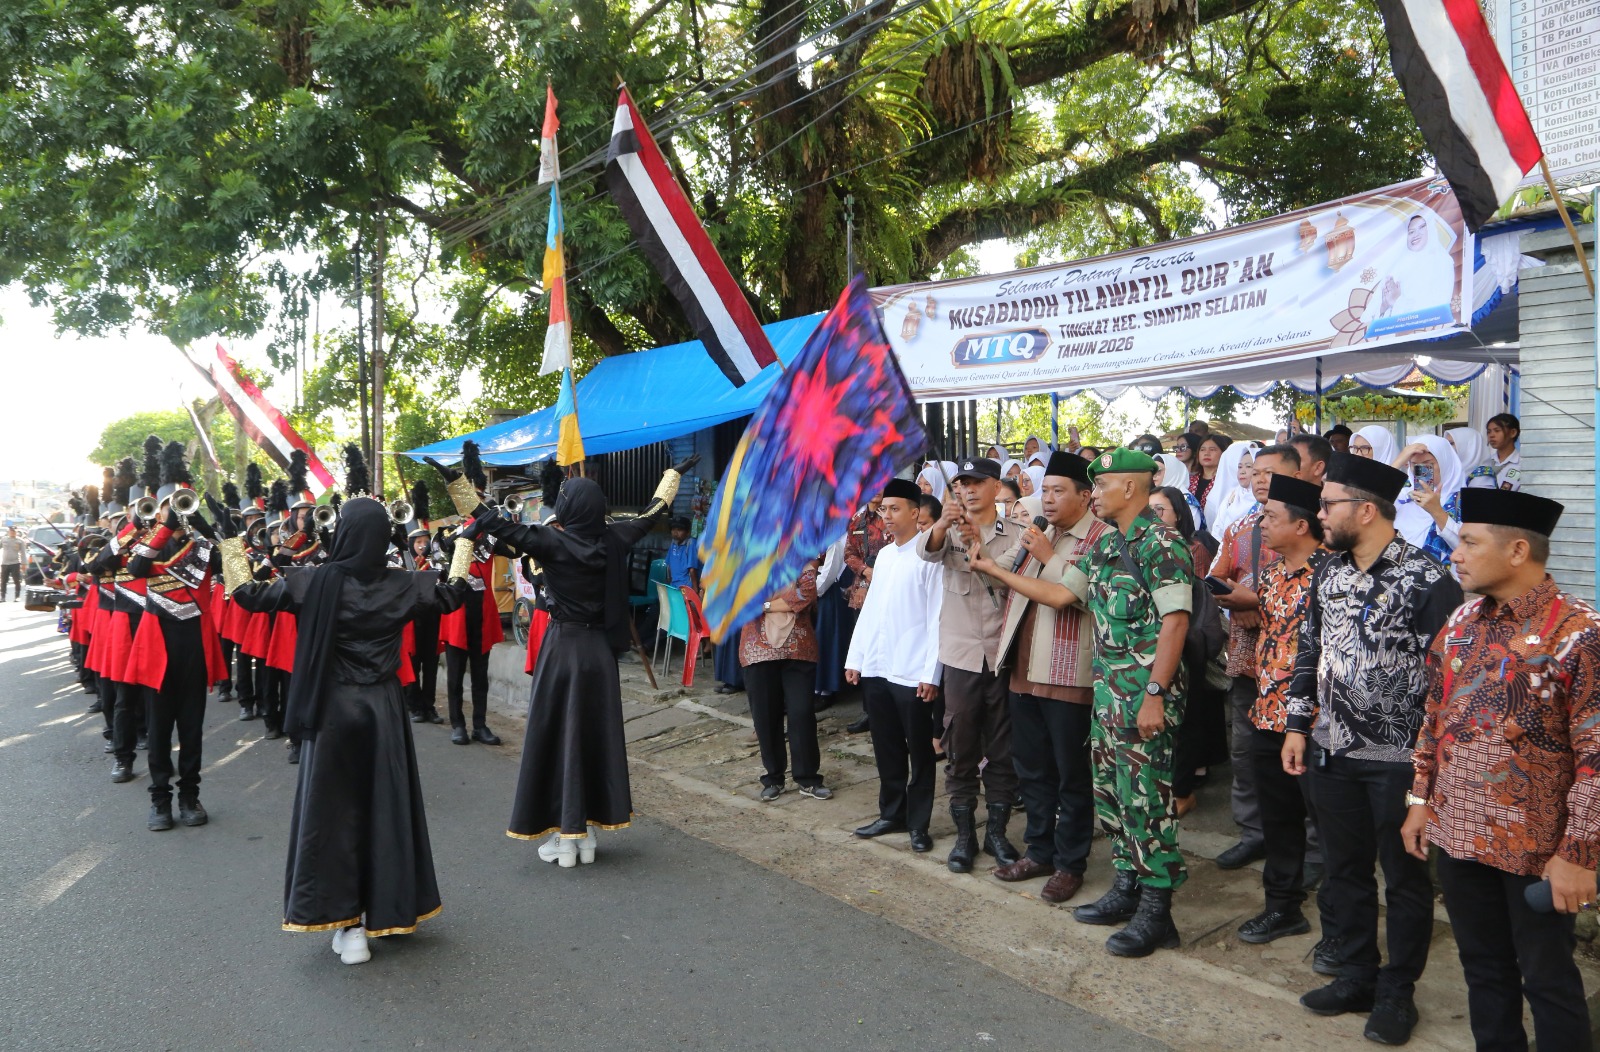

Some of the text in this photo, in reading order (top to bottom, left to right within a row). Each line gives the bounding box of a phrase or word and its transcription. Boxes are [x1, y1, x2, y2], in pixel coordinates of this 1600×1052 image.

[1521, 16, 1527, 24] 4
[1521, 29, 1528, 38] 5
[1542, 20, 1555, 31] KB
[1521, 26, 1582, 52] 6 TB Paru
[1522, 35, 1592, 65] 7 Imunisasi
[1522, 70, 1529, 79] 8
[1542, 59, 1560, 72] IVA
[1523, 63, 1597, 93] 9 Konsultasi
[1543, 77, 1597, 100] Konsultasi
[1543, 100, 1564, 113] VCT
[1567, 93, 1592, 110] (Test
[1544, 106, 1598, 128] Konsultasi
[1544, 123, 1594, 142] Konseling
[996, 250, 1195, 297] Selamat Datang Peserta
[949, 252, 1275, 330] MUSABAQOH TILAWATIL QUR'AN
[1059, 289, 1267, 339] TINGKAT KEC. SIANTAR SELATAN
[927, 375, 968, 384] Membangun
[969, 371, 1001, 382] Generasi
[1030, 366, 1061, 378] Menuju
[1061, 362, 1081, 373] Kota
[1082, 355, 1152, 373] Pematangsiantar
[1153, 347, 1186, 363] Cerdas,
[1187, 345, 1216, 358] Sehat,
[1218, 338, 1253, 353] Kreatif
[1252, 335, 1273, 347] dan
[1275, 329, 1313, 344] Selaras
[963, 333, 1035, 360] MTQ
[1057, 335, 1135, 359] TAHUN 2026
